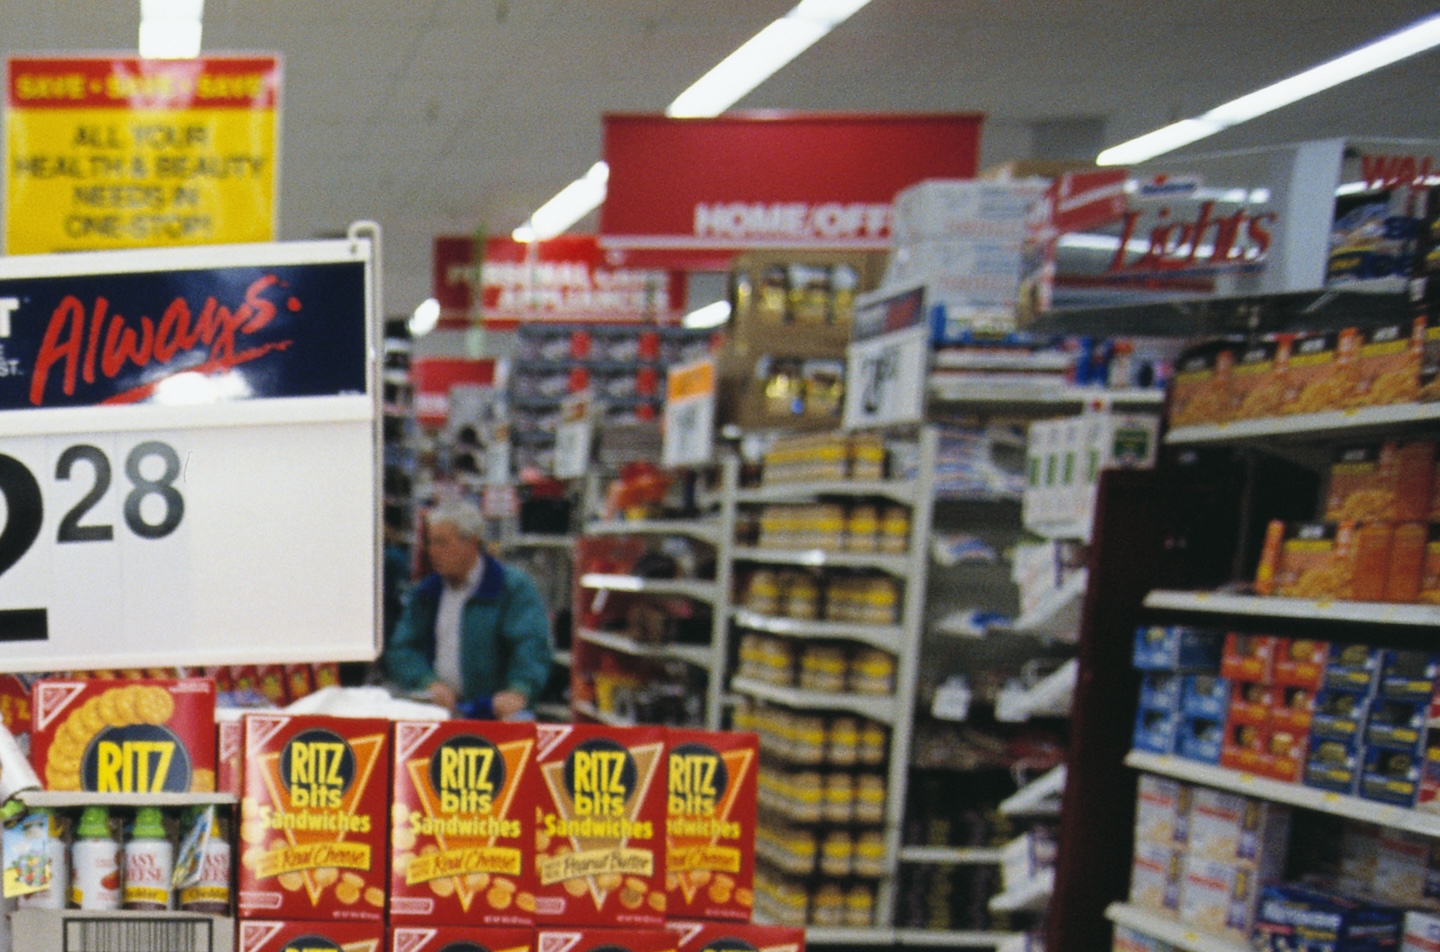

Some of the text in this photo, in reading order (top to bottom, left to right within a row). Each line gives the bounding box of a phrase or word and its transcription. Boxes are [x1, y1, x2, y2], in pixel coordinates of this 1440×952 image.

[15, 155, 124, 179] HEALTH
[157, 155, 266, 179] BEAUTY
[694, 202, 890, 238] HOME/OFF
[1109, 198, 1280, 273] Lights
[97, 740, 176, 792] RITZ
[290, 741, 345, 785] RITZ
[439, 746, 495, 791] RITZ
[573, 750, 627, 793] RITZ
[667, 753, 718, 796] RITZ
[289, 784, 343, 808] bits
[440, 790, 493, 814] bits
[573, 792, 625, 817] bits
[667, 792, 715, 816] bits
